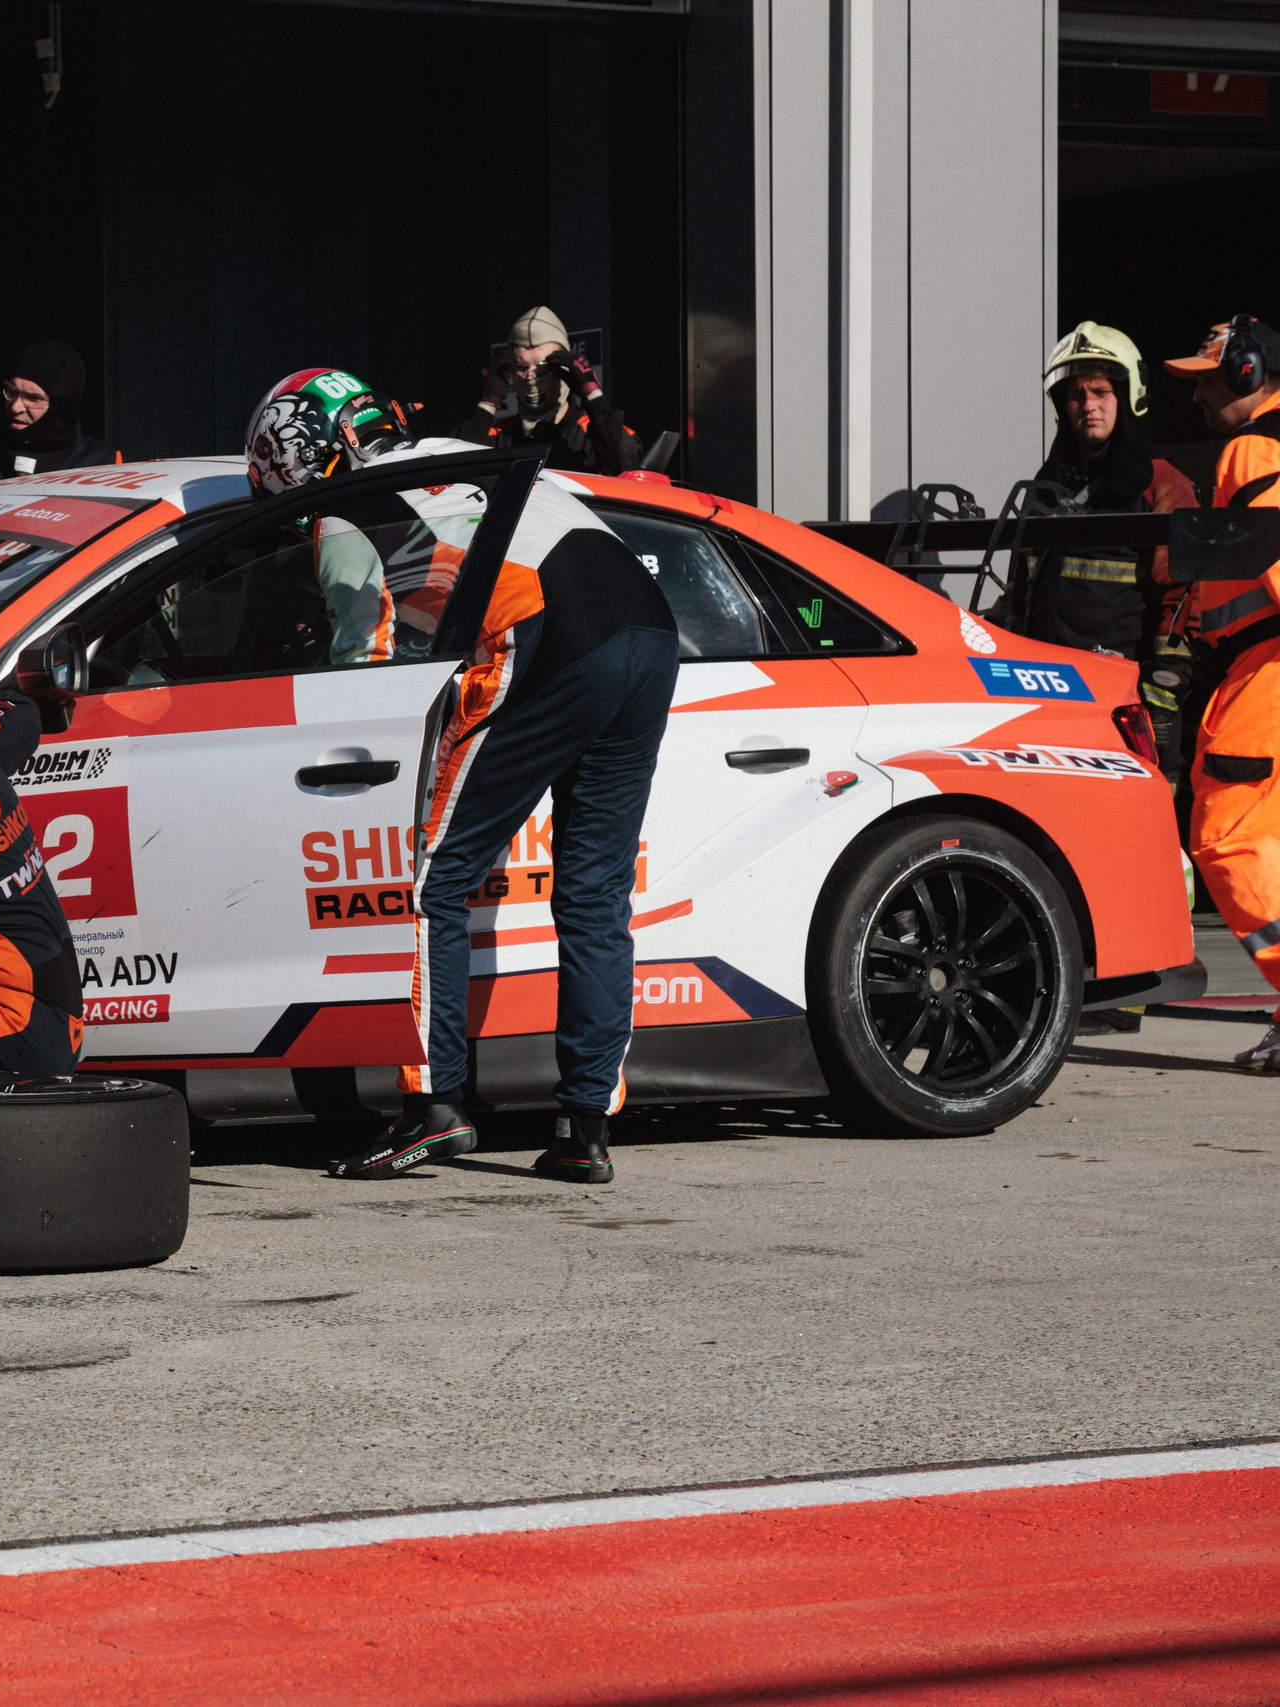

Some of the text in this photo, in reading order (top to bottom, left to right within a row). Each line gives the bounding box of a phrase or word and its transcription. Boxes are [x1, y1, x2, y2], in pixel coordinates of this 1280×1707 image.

[315, 372, 362, 399] 66
[14, 508, 69, 522] auto.ru
[1012, 668, 1070, 693] ВТБ
[109, 951, 179, 988] ADV
[391, 1147, 429, 1171] sparco
